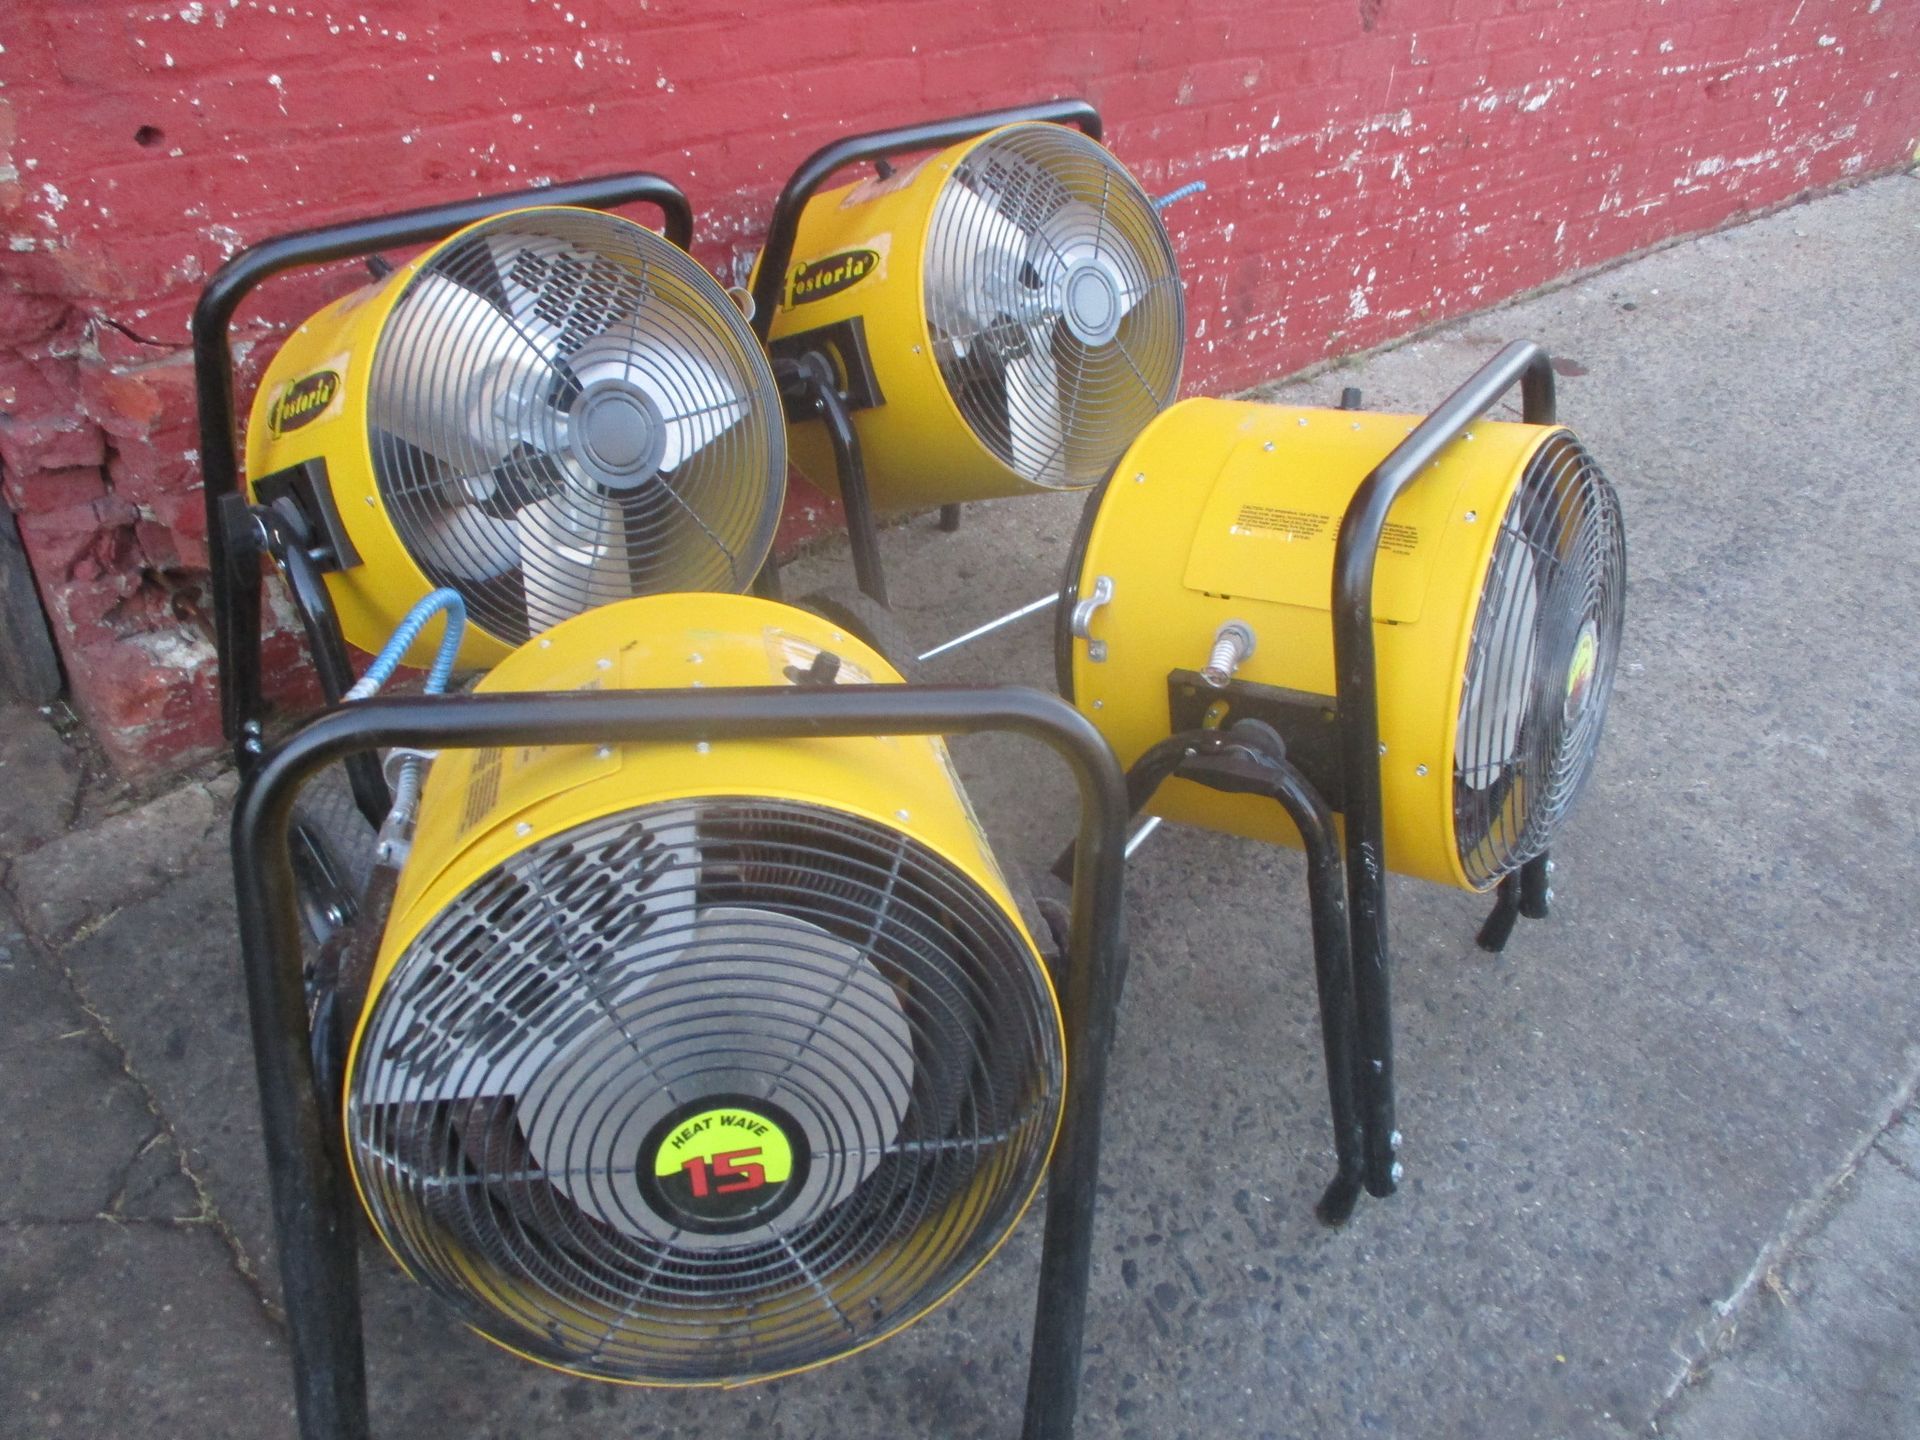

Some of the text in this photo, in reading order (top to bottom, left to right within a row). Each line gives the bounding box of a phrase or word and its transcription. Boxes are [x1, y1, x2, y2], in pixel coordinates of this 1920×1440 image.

[783, 256, 864, 312] fostoria
[272, 378, 330, 440] fostoria
[671, 1115, 769, 1150] HEAT WAVE
[681, 1147, 766, 1197] 15
